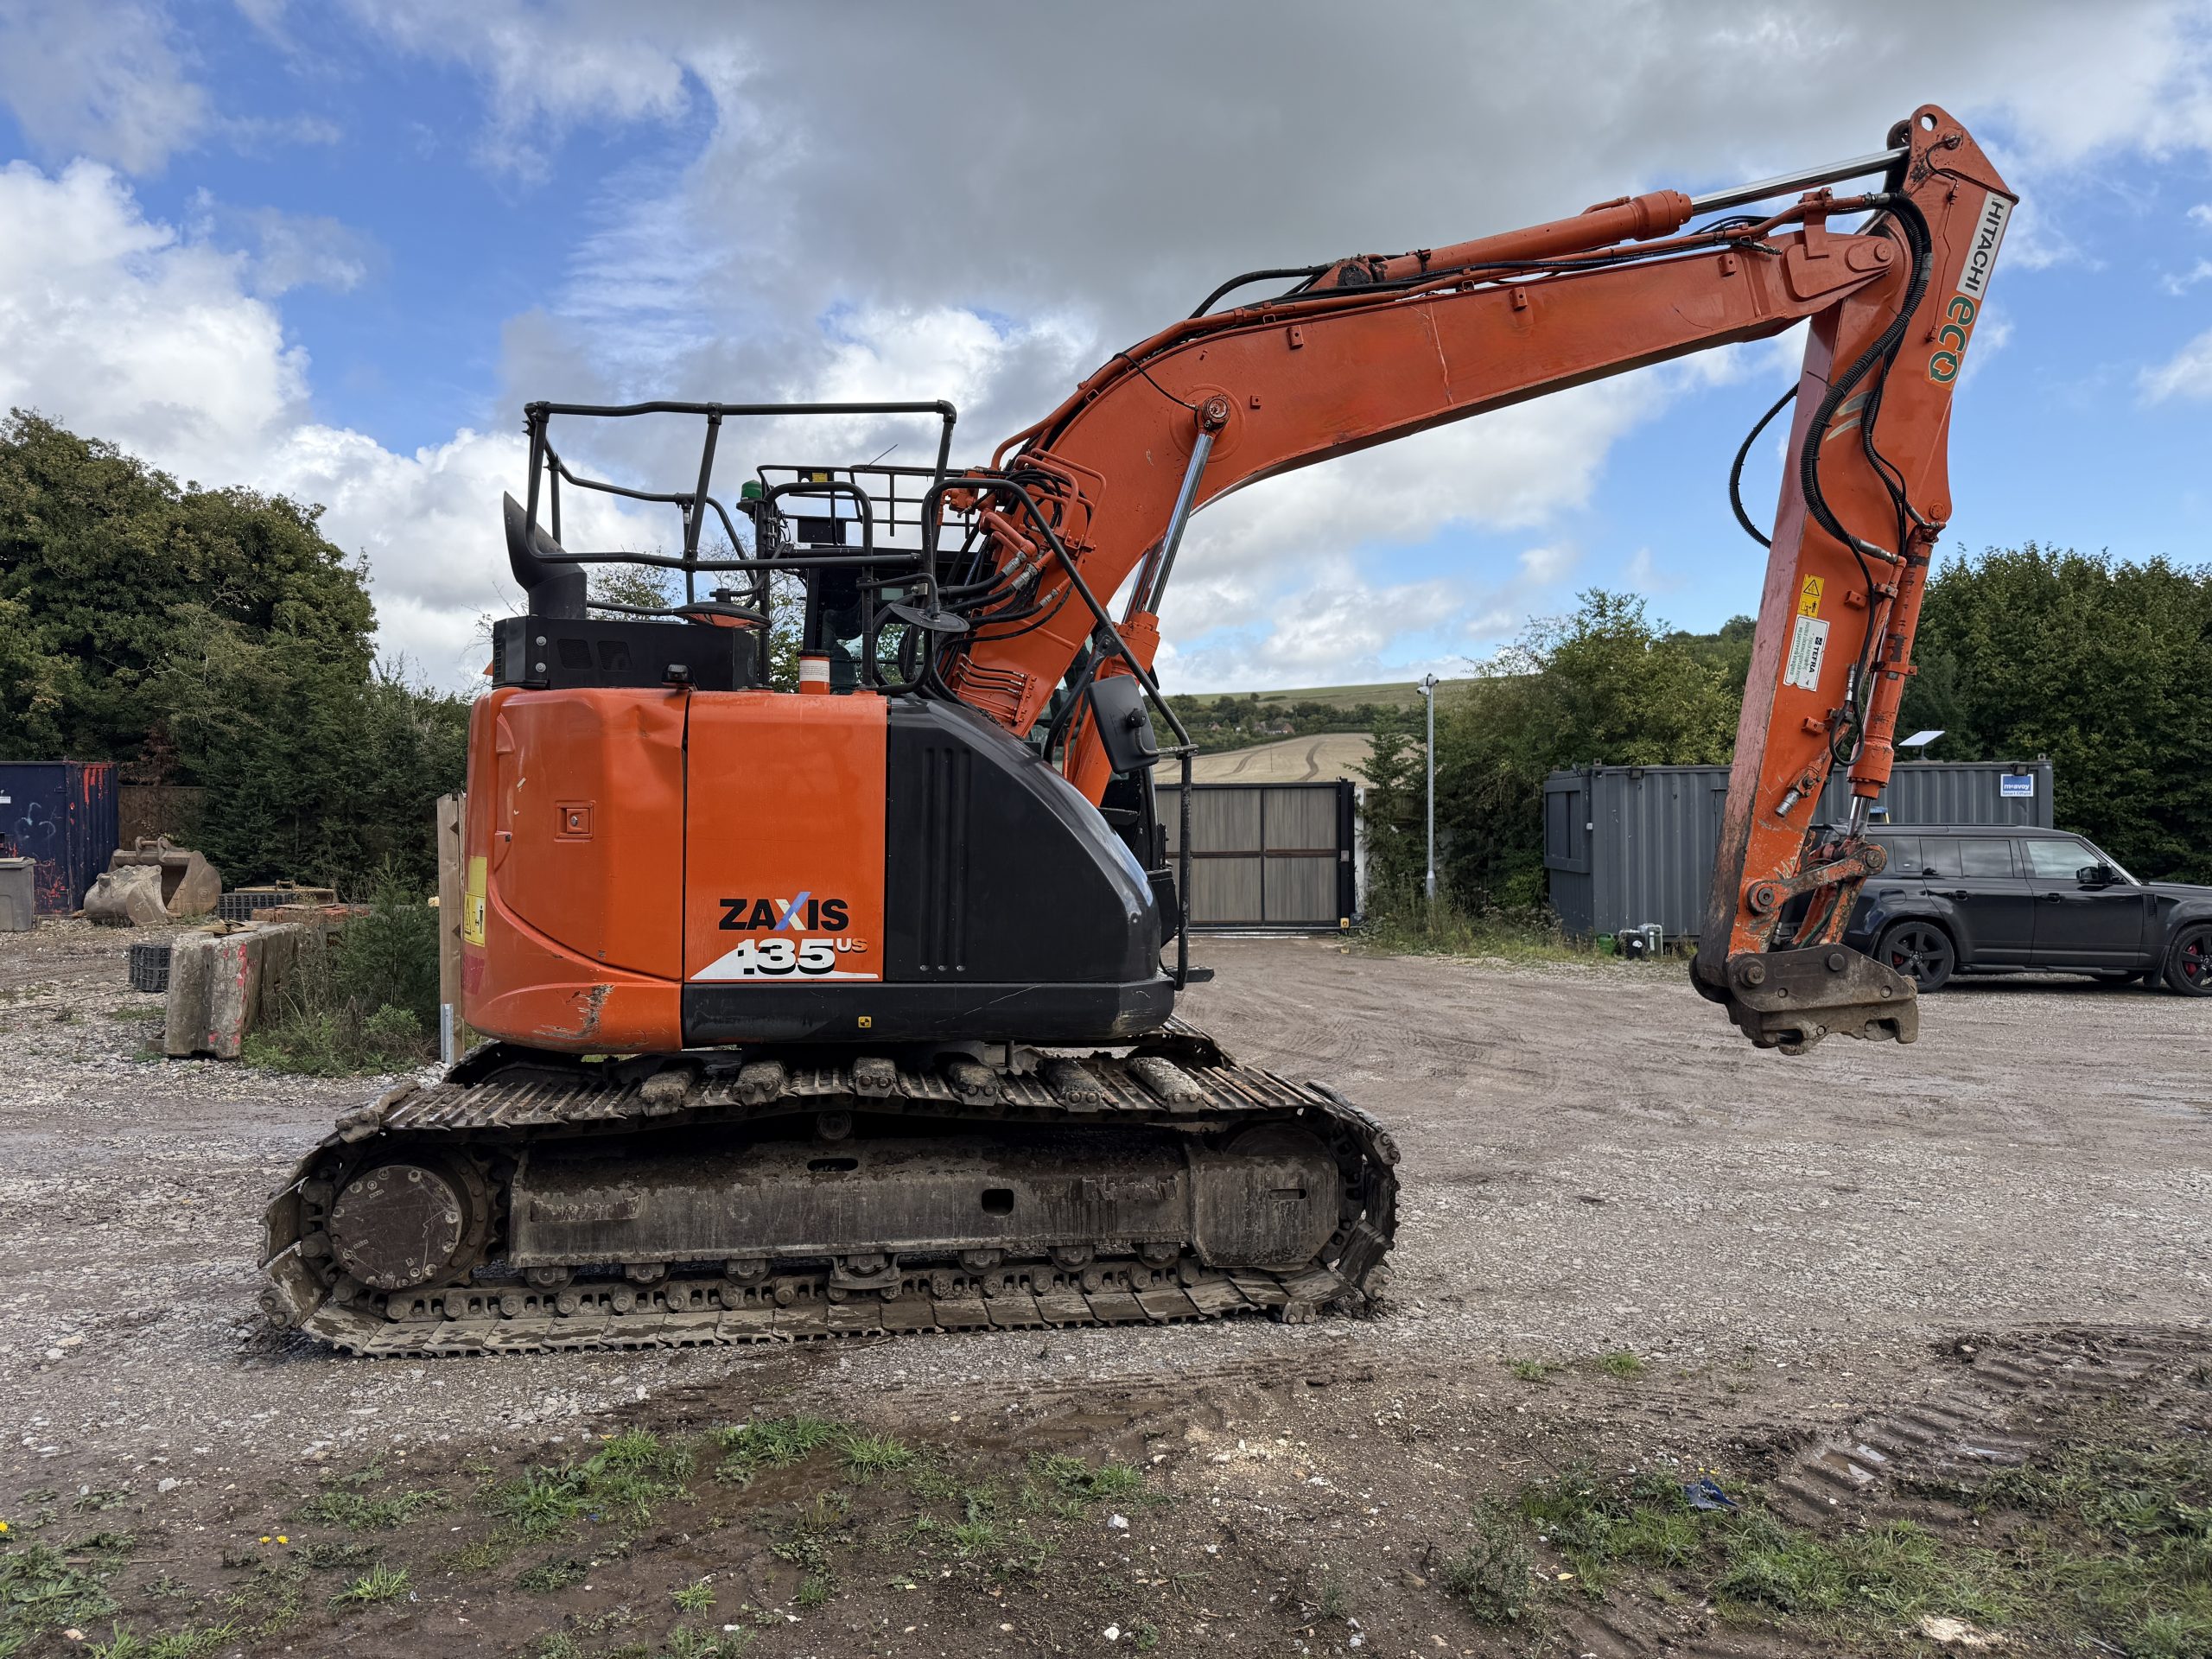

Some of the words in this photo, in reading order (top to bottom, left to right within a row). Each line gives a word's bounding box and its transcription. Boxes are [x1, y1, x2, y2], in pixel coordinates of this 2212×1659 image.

[1965, 200, 2005, 291] HITACHI
[1808, 646, 1819, 672] TEFRA
[718, 891, 849, 931] ZAXIS
[737, 938, 836, 975] 135
[836, 938, 868, 953] US
